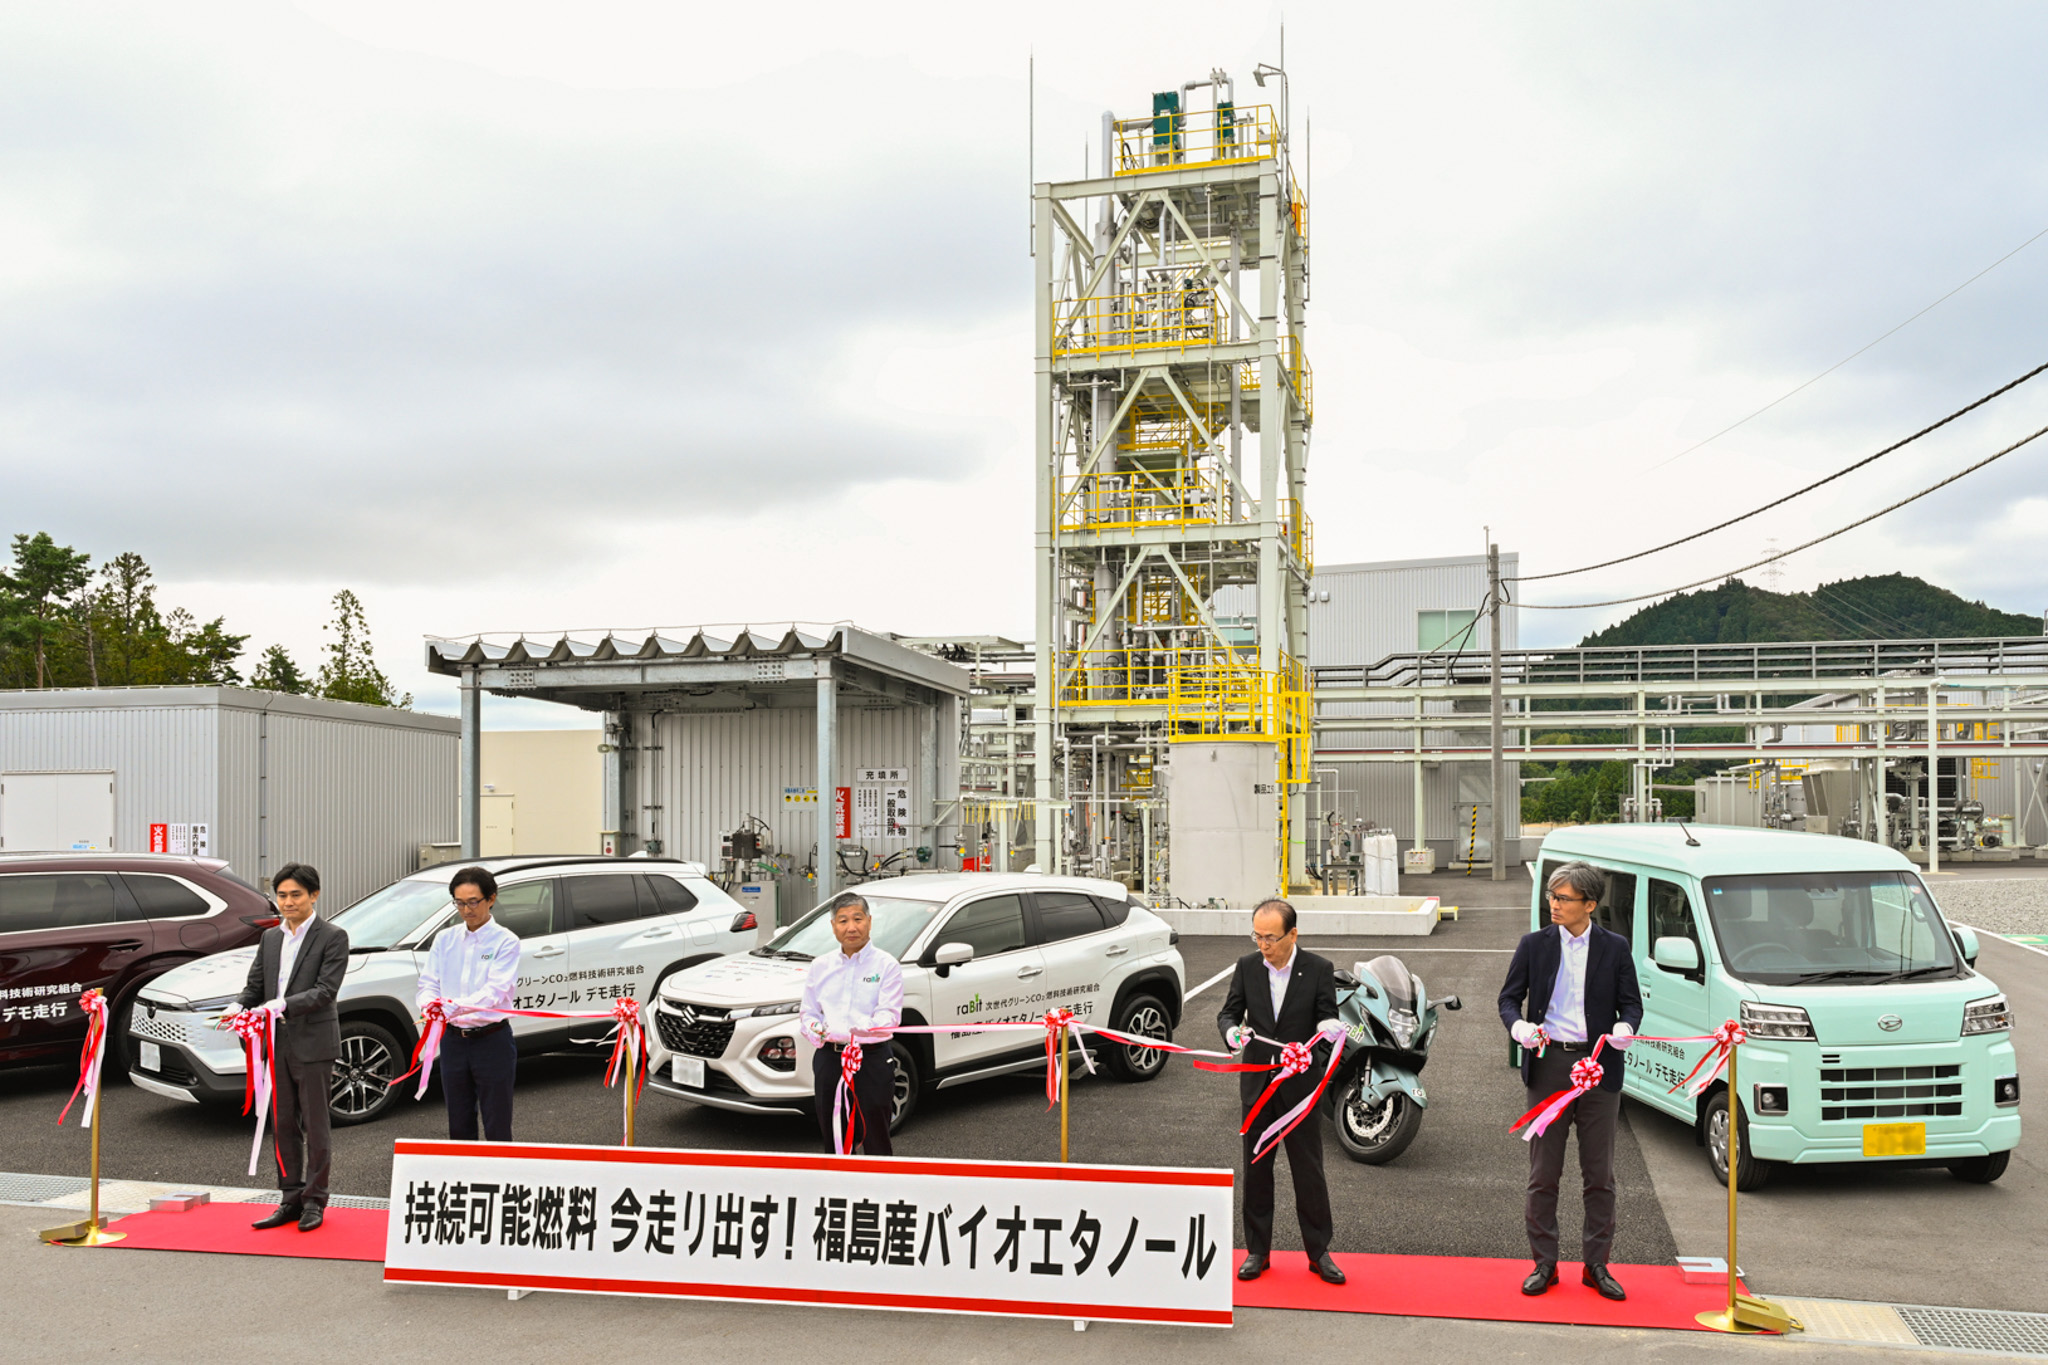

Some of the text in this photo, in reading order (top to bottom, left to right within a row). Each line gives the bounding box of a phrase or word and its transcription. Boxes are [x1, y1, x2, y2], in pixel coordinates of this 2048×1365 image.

[865, 770, 899, 780] 充填所
[897, 789, 907, 837] 危険物
[586, 982, 636, 1002] デモ走行
[2, 1002, 68, 1022] デモ走行
[956, 993, 982, 1015] raBit
[405, 1181, 598, 1252] 持続可能燃料
[812, 1196, 1218, 1281] 福島産バイオエタノール
